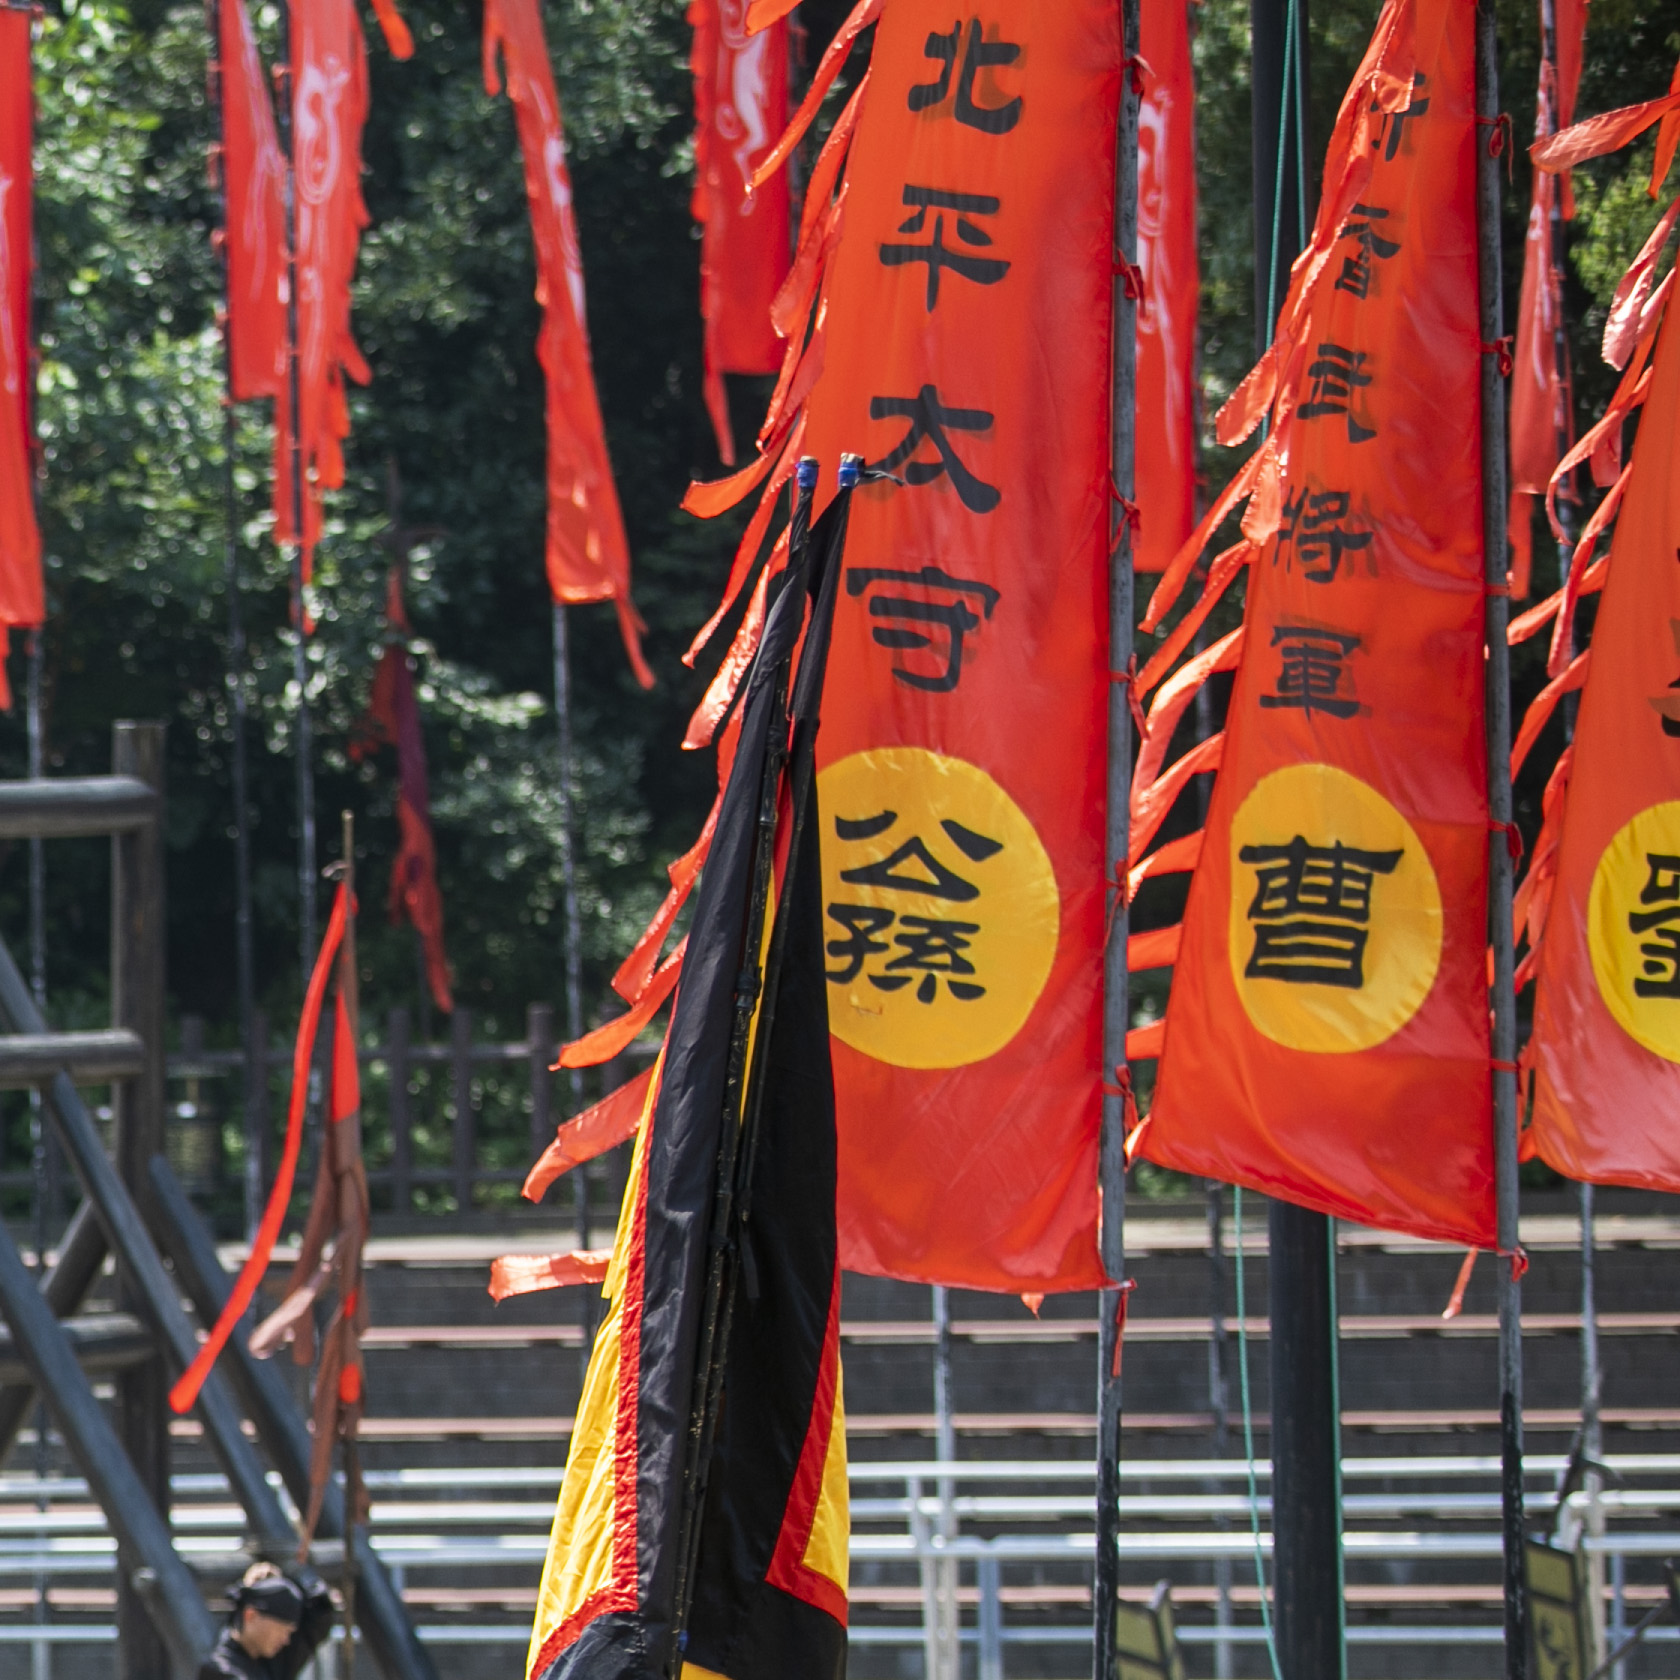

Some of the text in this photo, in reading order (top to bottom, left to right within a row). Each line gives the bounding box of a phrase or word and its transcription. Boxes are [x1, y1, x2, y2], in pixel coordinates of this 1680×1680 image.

[845, 17, 1024, 694] 北平太守
[825, 809, 1004, 1004] 公孫
[1238, 833, 1405, 990] 曹
